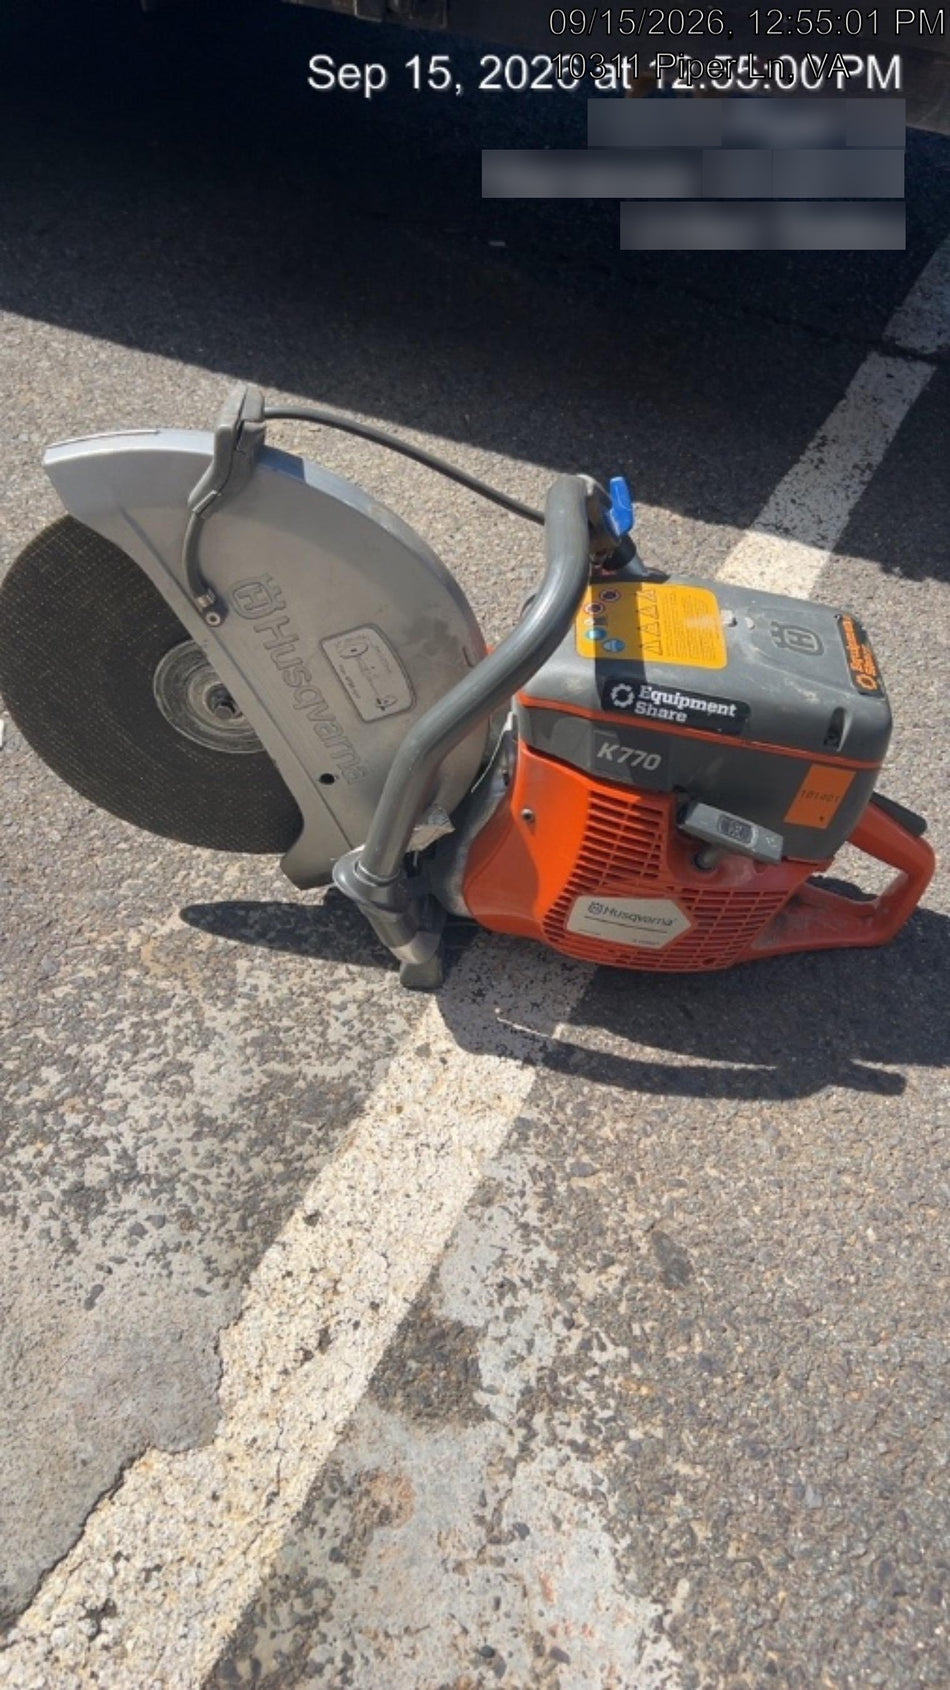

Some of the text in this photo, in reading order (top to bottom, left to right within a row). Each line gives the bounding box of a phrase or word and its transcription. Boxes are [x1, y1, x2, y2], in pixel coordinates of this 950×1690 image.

[633, 700, 688, 723] Share
[638, 684, 738, 718] Equipment
[597, 742, 662, 771] K770
[603, 905, 674, 927] Husqvarna
